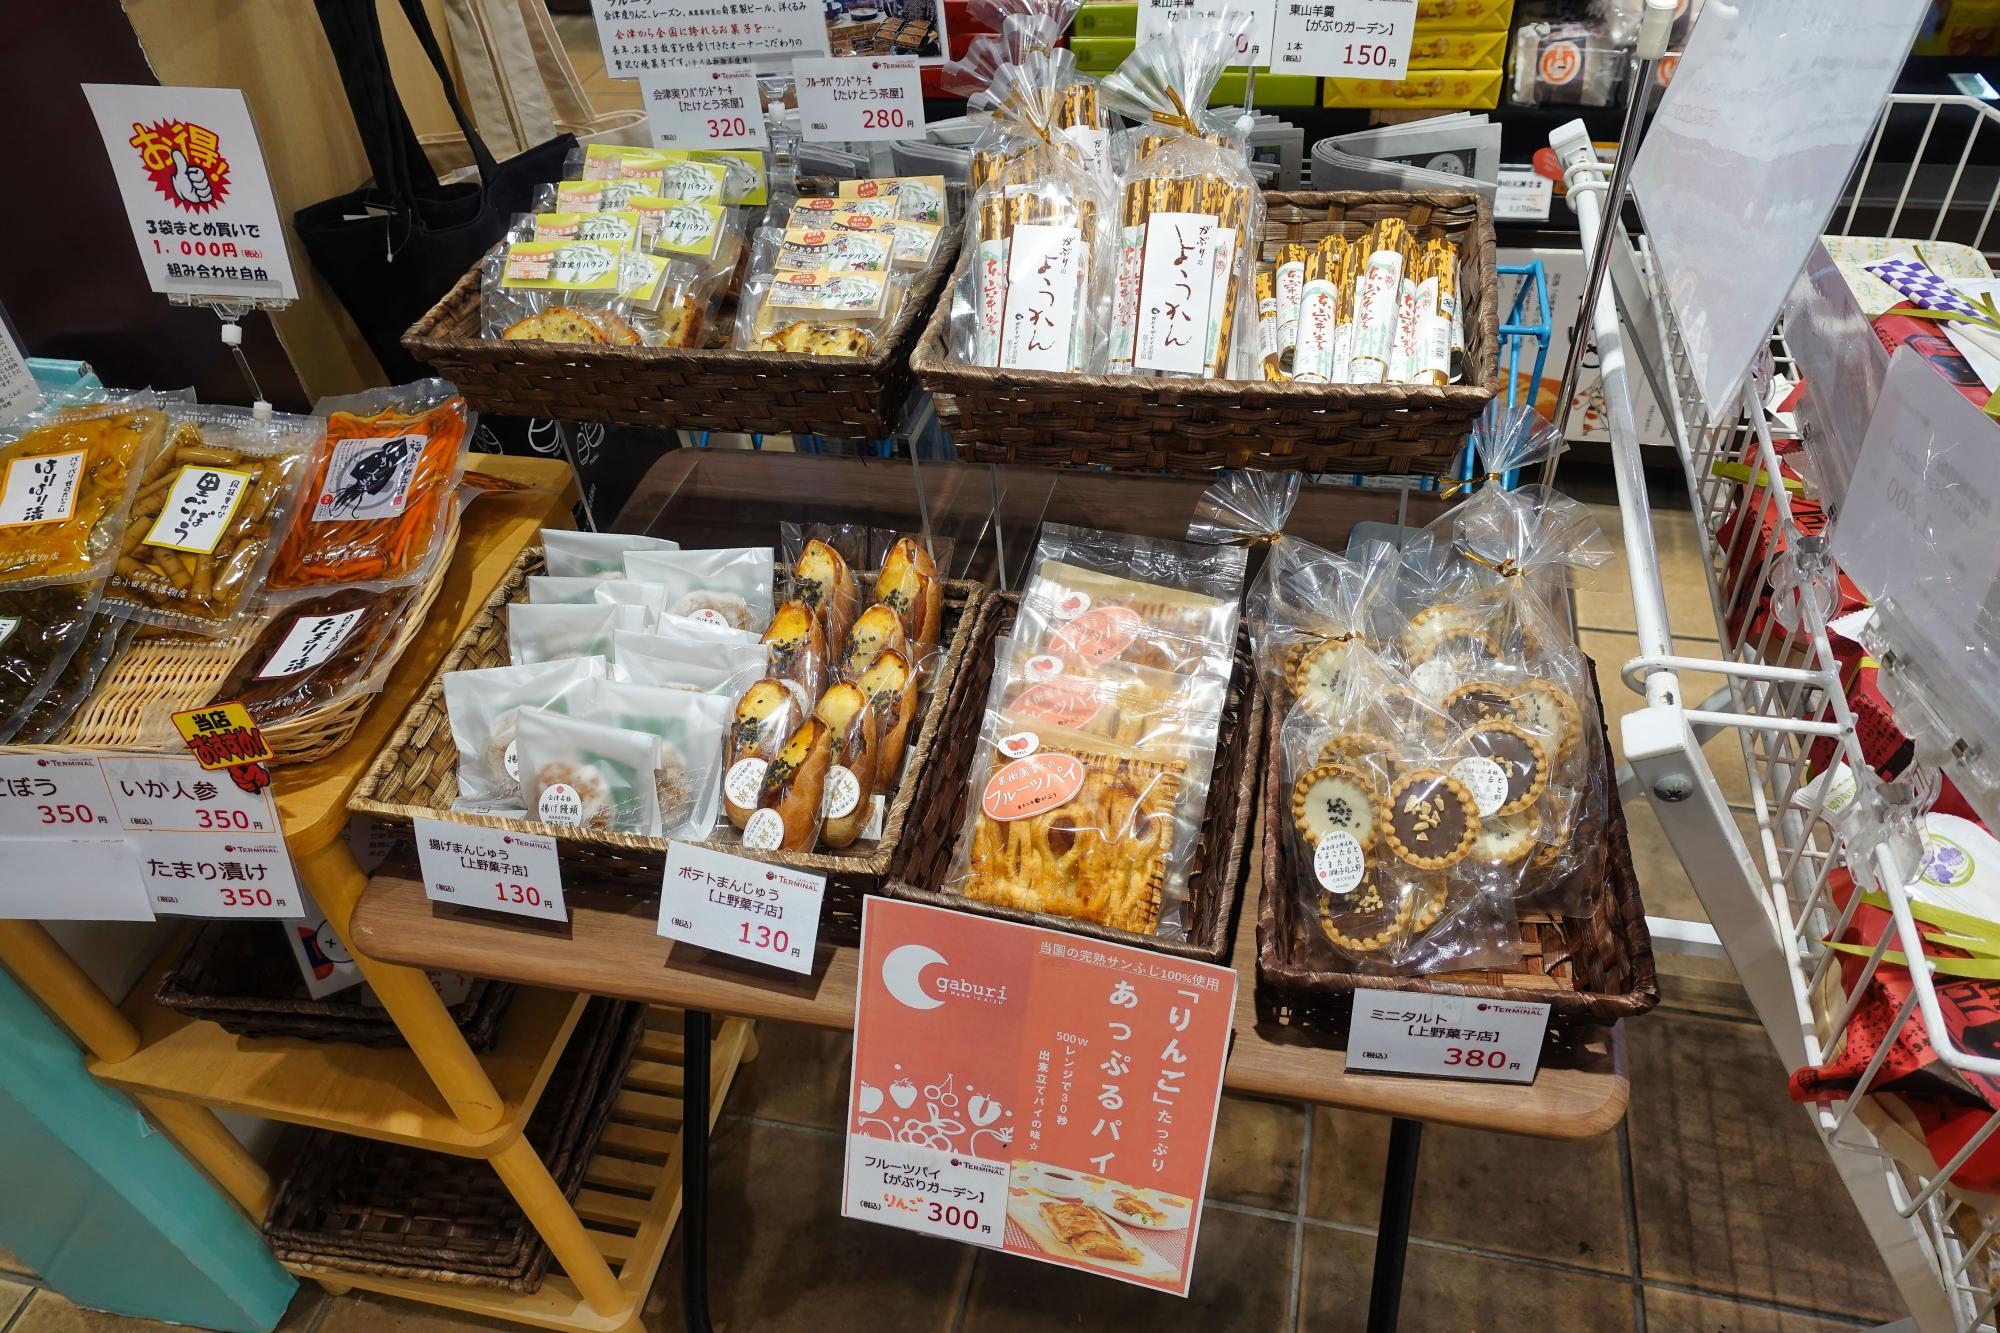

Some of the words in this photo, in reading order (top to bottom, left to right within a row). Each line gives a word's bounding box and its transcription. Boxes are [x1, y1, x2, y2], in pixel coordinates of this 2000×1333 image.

[1289, 5, 1335, 18] 東山羊羹
[1304, 20, 1395, 35] 【がぶりガーデン】
[832, 88, 905, 101] 【たけとう茶屋】
[679, 98, 744, 112] 【たけとう茶屋】
[146, 220, 261, 238] 3袋まとめ買いで
[191, 710, 231, 732] 当店
[51, 759, 95, 767] TERMINAL
[120, 779, 219, 801] いか人参
[985, 762, 1076, 813] フルーツパイ
[236, 846, 278, 854] TERMINAL
[429, 838, 510, 860] 揚げまんじゅう
[515, 839, 553, 851] TERMINAL
[147, 859, 268, 882] たまり漬け
[460, 857, 529, 878] 【上野菓子店】
[678, 865, 780, 902] ポテトまんじゅう
[779, 875, 819, 892] TERMINAL
[708, 888, 785, 920] 【上野菓子店】
[1039, 940, 1220, 992] 当園の完熟サンふじ100%使用
[935, 976, 1008, 1001] gaburi
[1370, 1008, 1449, 1025] ミニタルト
[1493, 1005, 1543, 1016] TERMINAL
[1407, 1024, 1501, 1044] 【上野菓子店】
[864, 1154, 942, 1180] フルーツパイ
[963, 1161, 1005, 1177] TERMINAL
[881, 1172, 986, 1204] 【がぶりガーデン】
